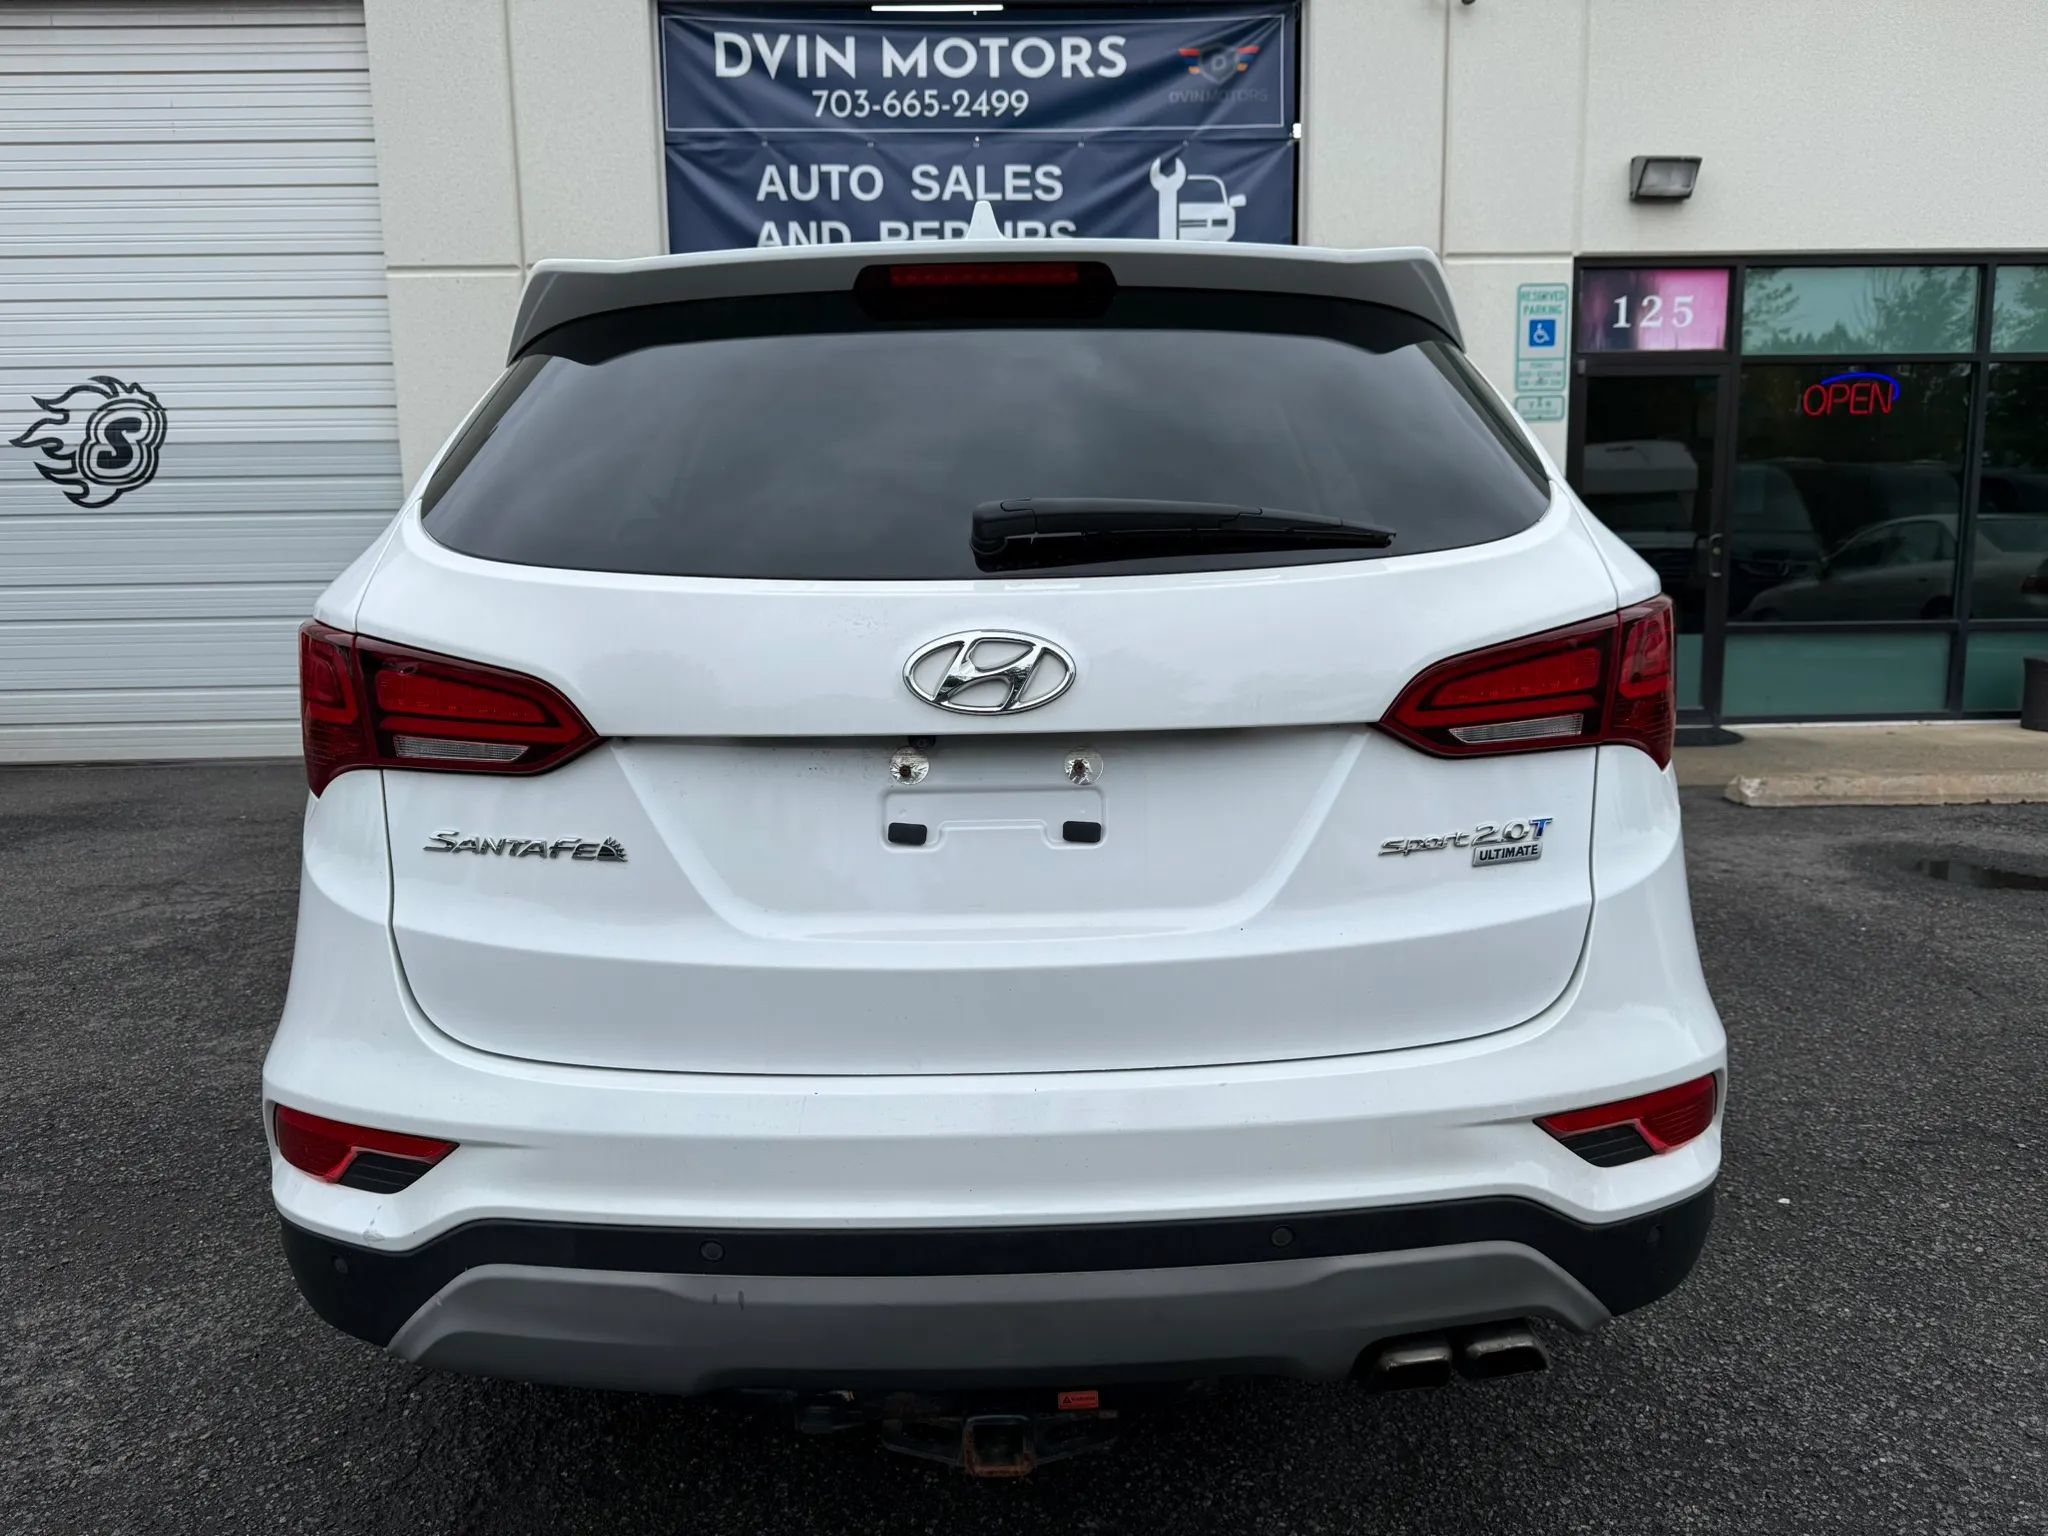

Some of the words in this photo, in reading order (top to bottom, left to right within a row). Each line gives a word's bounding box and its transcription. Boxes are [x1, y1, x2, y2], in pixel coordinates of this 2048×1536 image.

[713, 31, 856, 80] DVIN
[881, 35, 1128, 79] MOTORS
[812, 88, 1030, 118] 703-665-2499
[756, 164, 884, 202] AUTO
[910, 164, 1064, 202] SALES
[756, 220, 853, 248] AND
[1612, 294, 1695, 328] 125
[1803, 382, 1895, 417] OPEN
[1478, 844, 1538, 861] ULTIMATE
